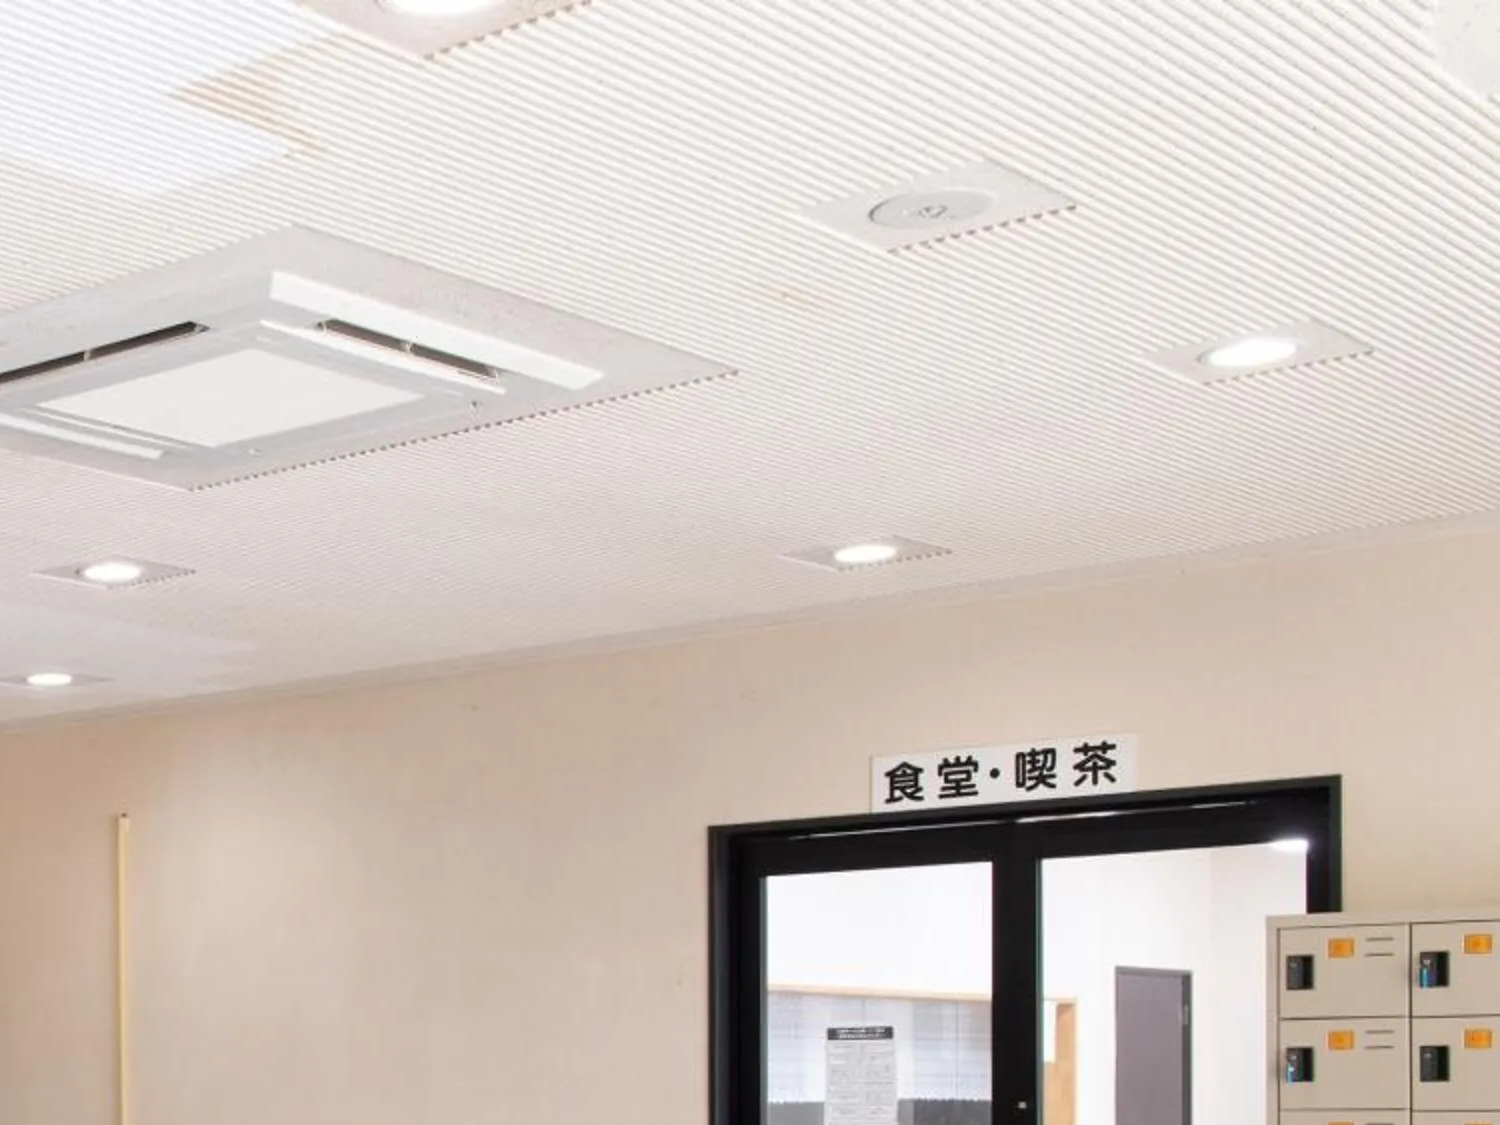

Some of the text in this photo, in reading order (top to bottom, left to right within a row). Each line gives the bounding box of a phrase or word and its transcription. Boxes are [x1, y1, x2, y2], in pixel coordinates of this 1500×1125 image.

[883, 740, 1118, 804] 食堂・喫茶
